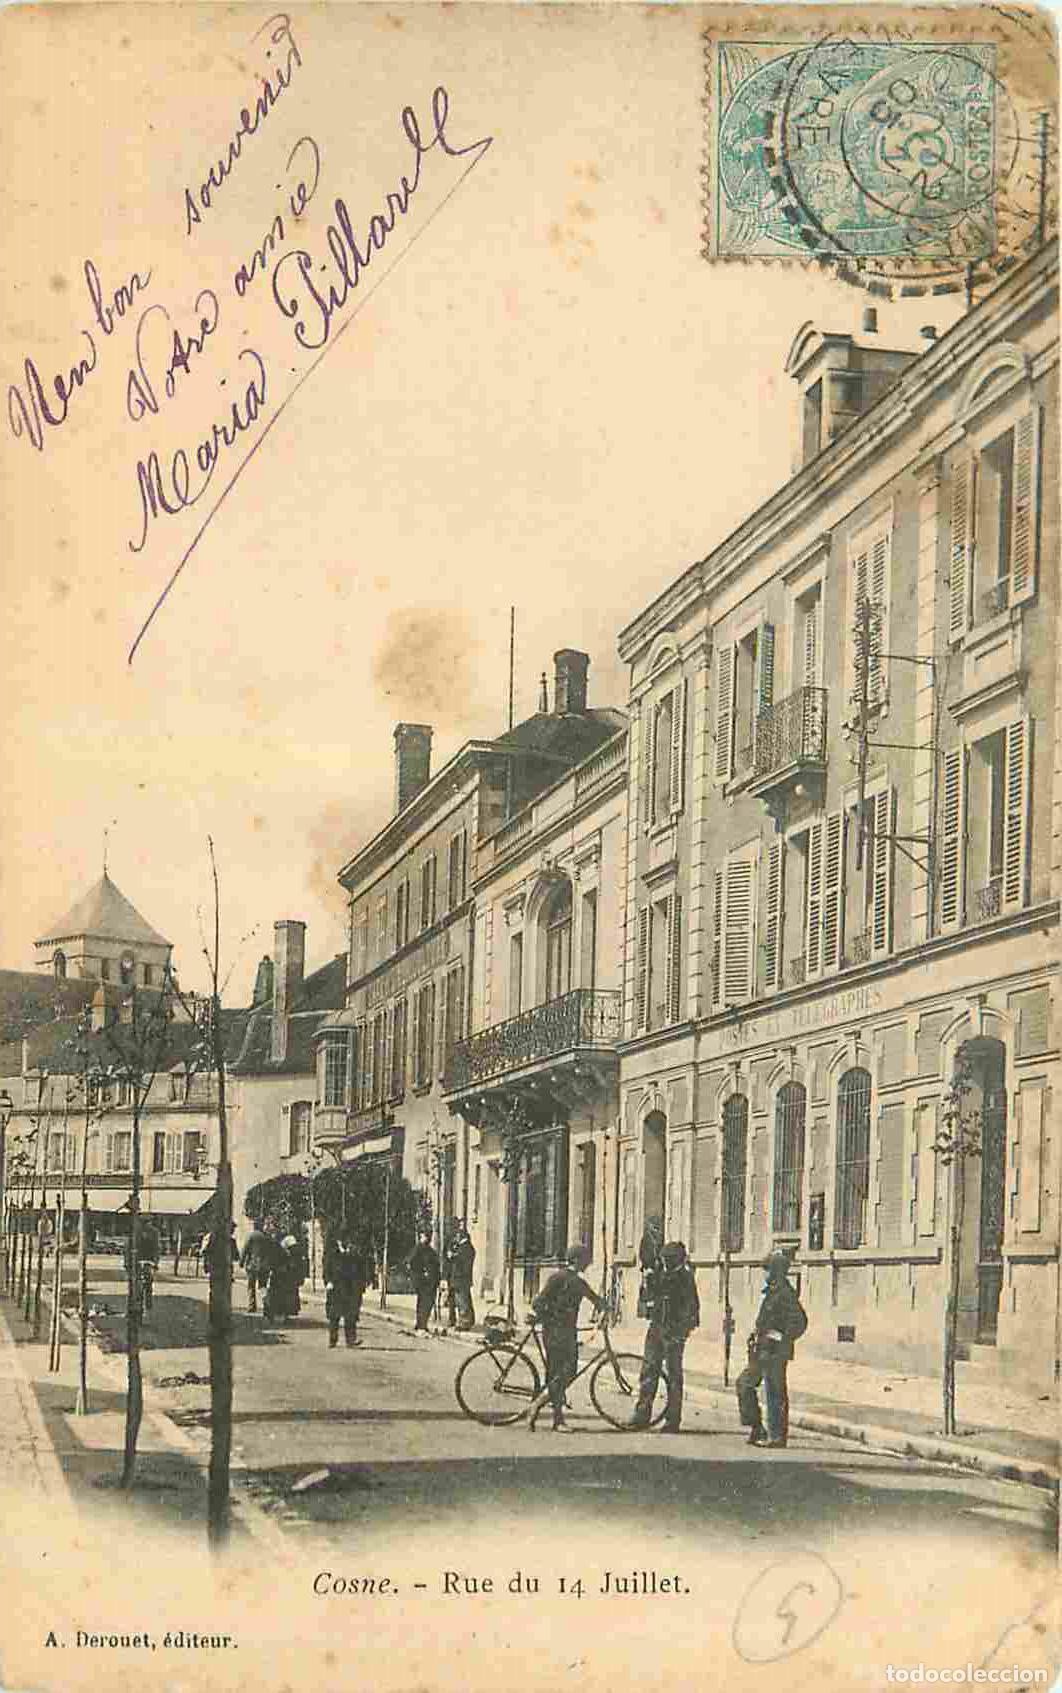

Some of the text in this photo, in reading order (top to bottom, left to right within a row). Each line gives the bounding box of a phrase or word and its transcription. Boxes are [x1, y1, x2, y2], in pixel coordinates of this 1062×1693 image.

[84, 260, 152, 334] bon
[184, 14, 301, 235] souvenir
[127, 136, 319, 420] Votre amie
[130, 349, 266, 553] Maria
